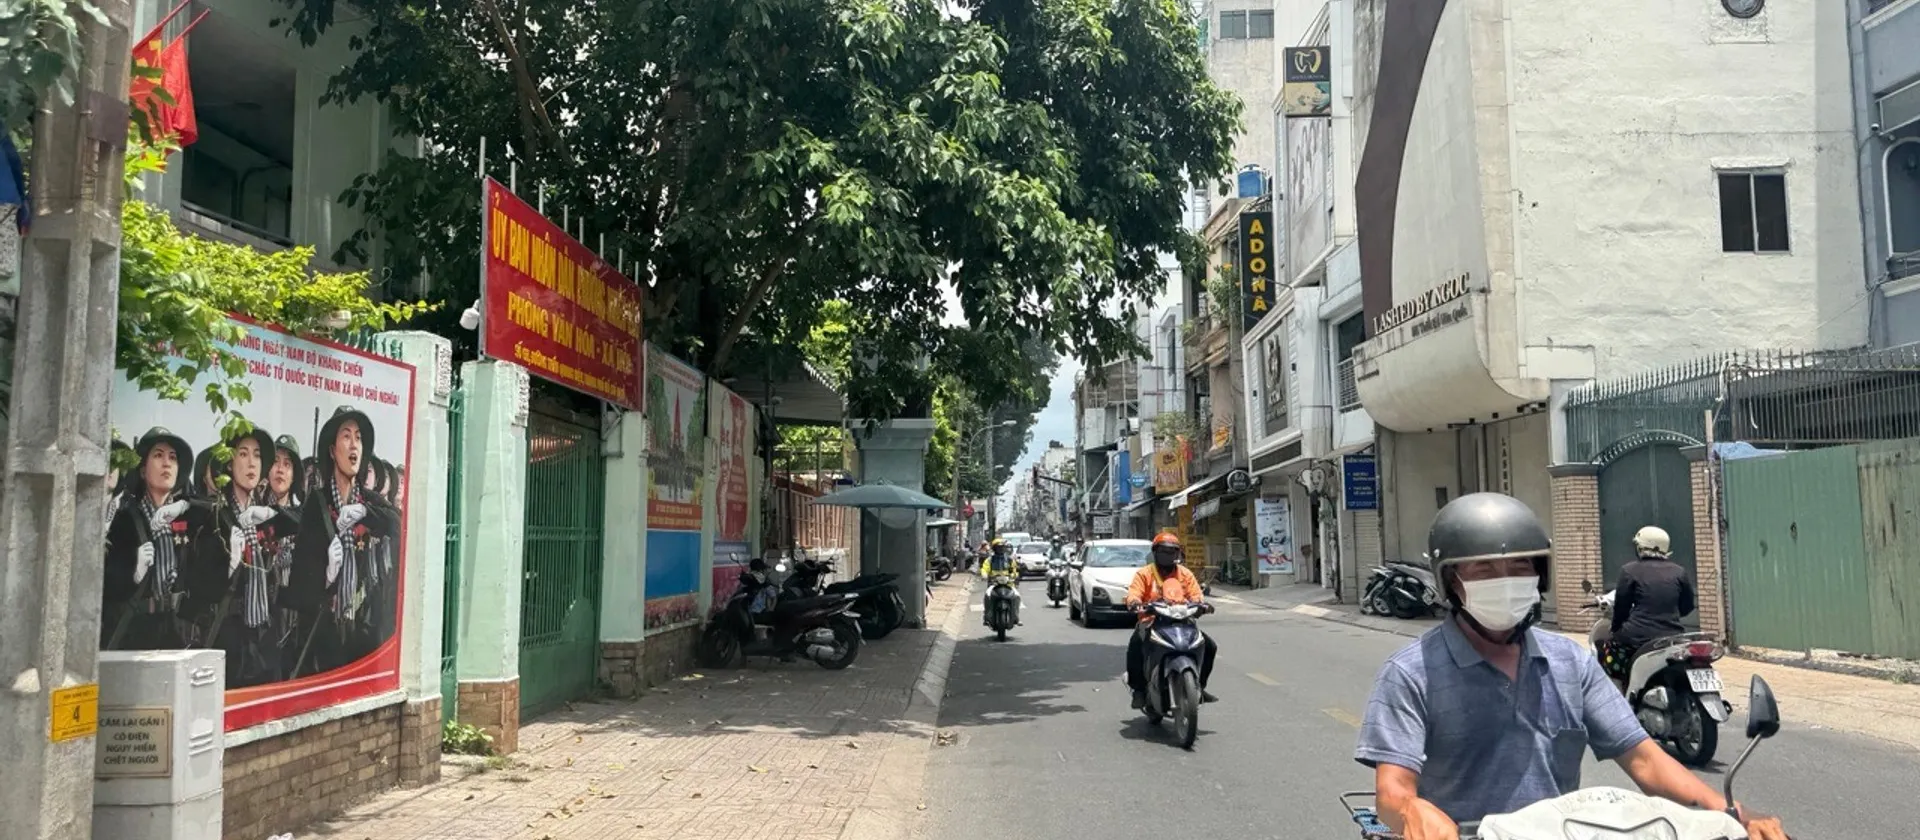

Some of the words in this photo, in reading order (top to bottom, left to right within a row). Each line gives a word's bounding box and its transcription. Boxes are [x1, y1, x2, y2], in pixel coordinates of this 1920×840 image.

[509, 218, 530, 275] BAN
[531, 231, 556, 290] NHÂN
[508, 291, 549, 338] PHÒNG
[551, 313, 573, 349] VĂN
[575, 323, 595, 359] HÓA
[1373, 300, 1416, 335] LASHED
[1416, 289, 1434, 316] BY
[248, 357, 271, 378] CHẮC
[273, 362, 284, 380] TỔ
[285, 366, 306, 385] QUỐC
[307, 372, 323, 391] VIỆT
[324, 377, 341, 393] NAM
[342, 381, 351, 395] XÃ
[352, 383, 364, 401] HỘI
[365, 385, 378, 402] CHỦ
[286, 346, 304, 362] NAM
[306, 350, 317, 368] BỘ
[318, 354, 341, 372] KHÁNG
[343, 361, 364, 377] CHIẾN
[72, 705, 80, 723] 4
[103, 755, 127, 765] CHẾT
[106, 744, 131, 753] NGUY
[133, 742, 157, 752] HIỂM
